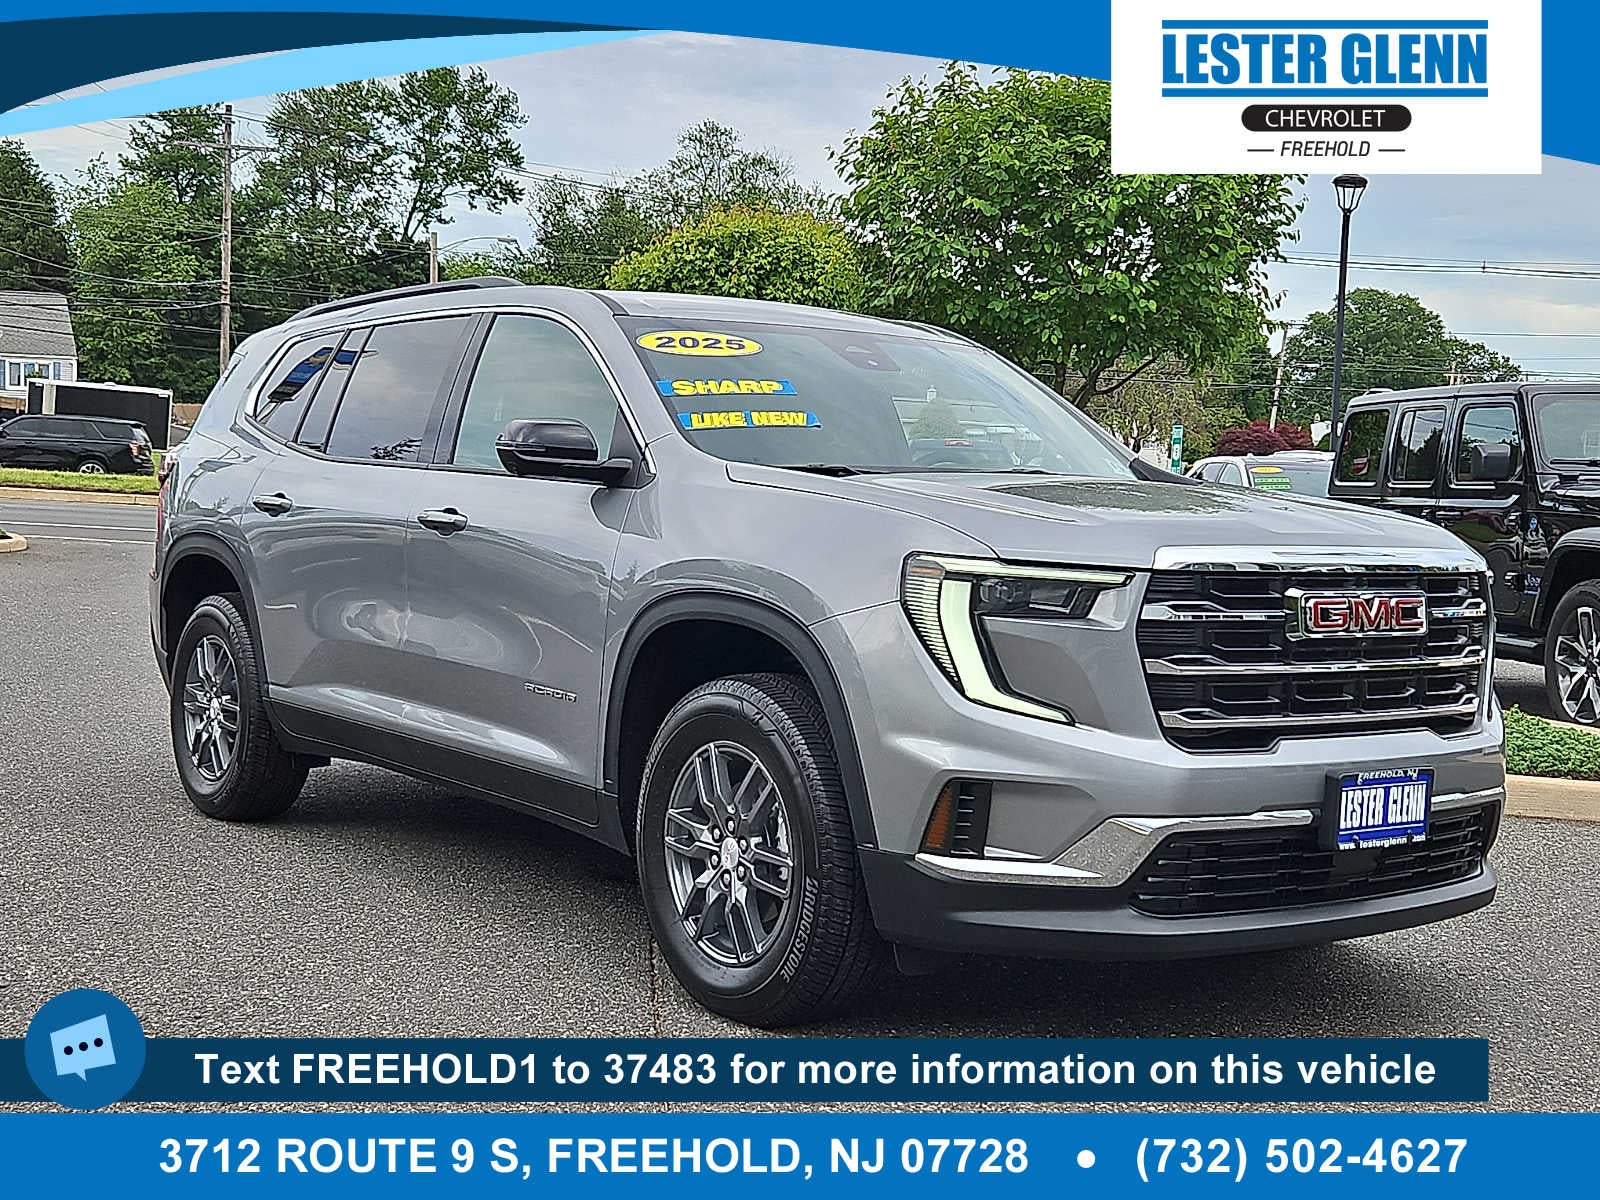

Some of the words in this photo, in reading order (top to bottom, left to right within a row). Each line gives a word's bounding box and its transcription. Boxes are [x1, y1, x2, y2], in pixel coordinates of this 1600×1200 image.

[655, 336, 746, 351] 2025
[671, 379, 783, 396] SHARP
[690, 411, 744, 427] LIKE
[750, 411, 807, 427] NEW
[1310, 598, 1424, 630] GMC
[1340, 788, 1384, 829] LESTER
[1387, 784, 1427, 824] GLENN
[780, 876, 819, 983] BRIDGESTONE
